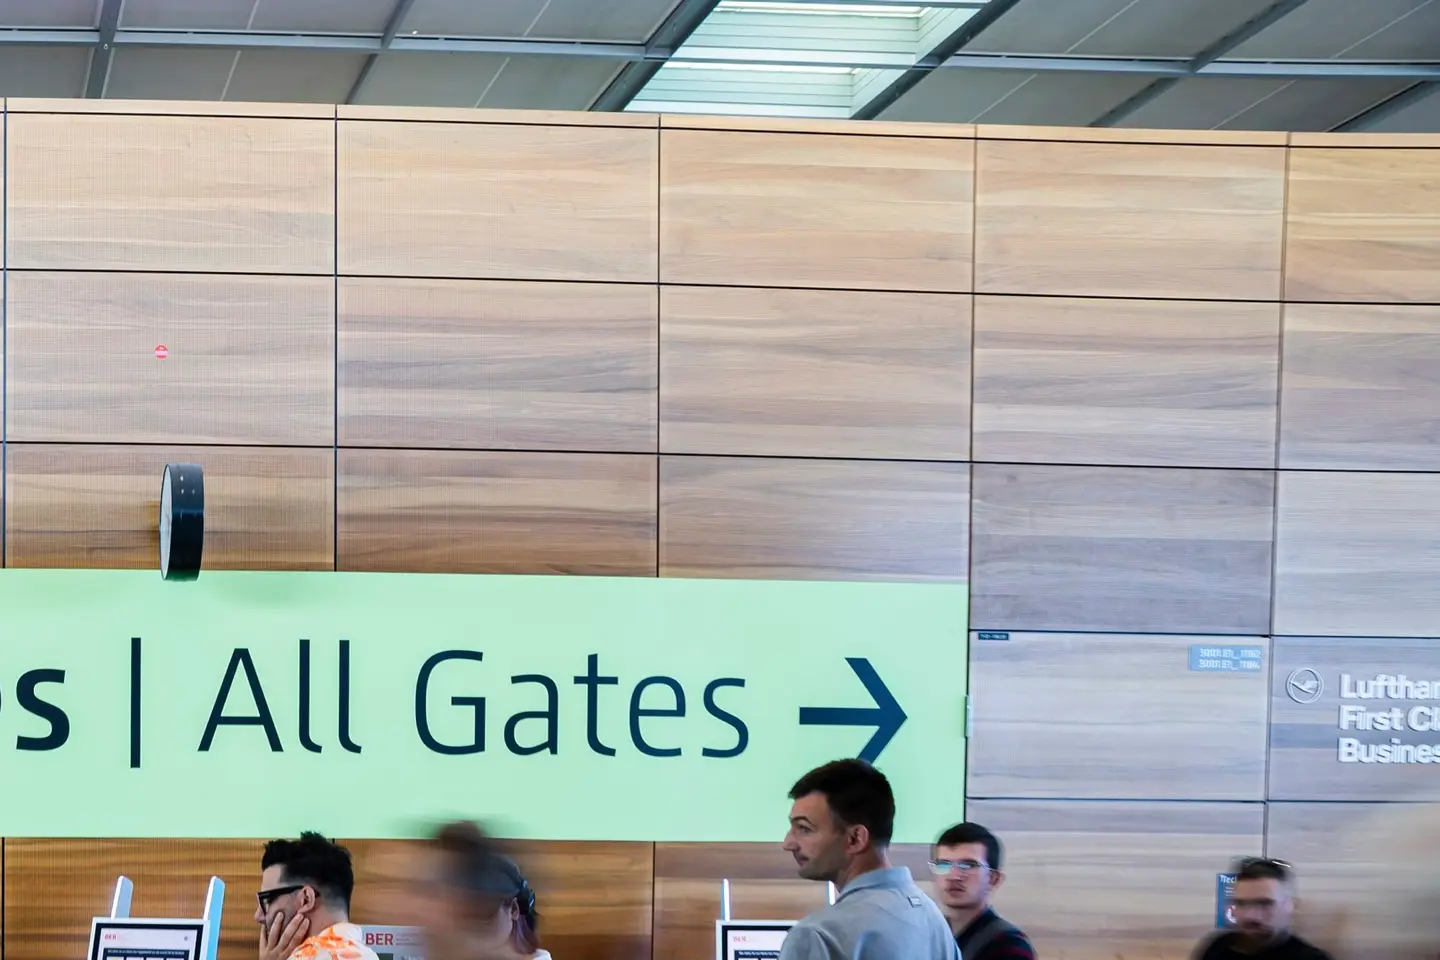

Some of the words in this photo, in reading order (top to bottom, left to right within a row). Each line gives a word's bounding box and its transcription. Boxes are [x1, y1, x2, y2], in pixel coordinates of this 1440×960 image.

[197, 639, 363, 755] All
[414, 649, 749, 759] Gates
[1339, 704, 1405, 732] First
[365, 932, 394, 946] BER
